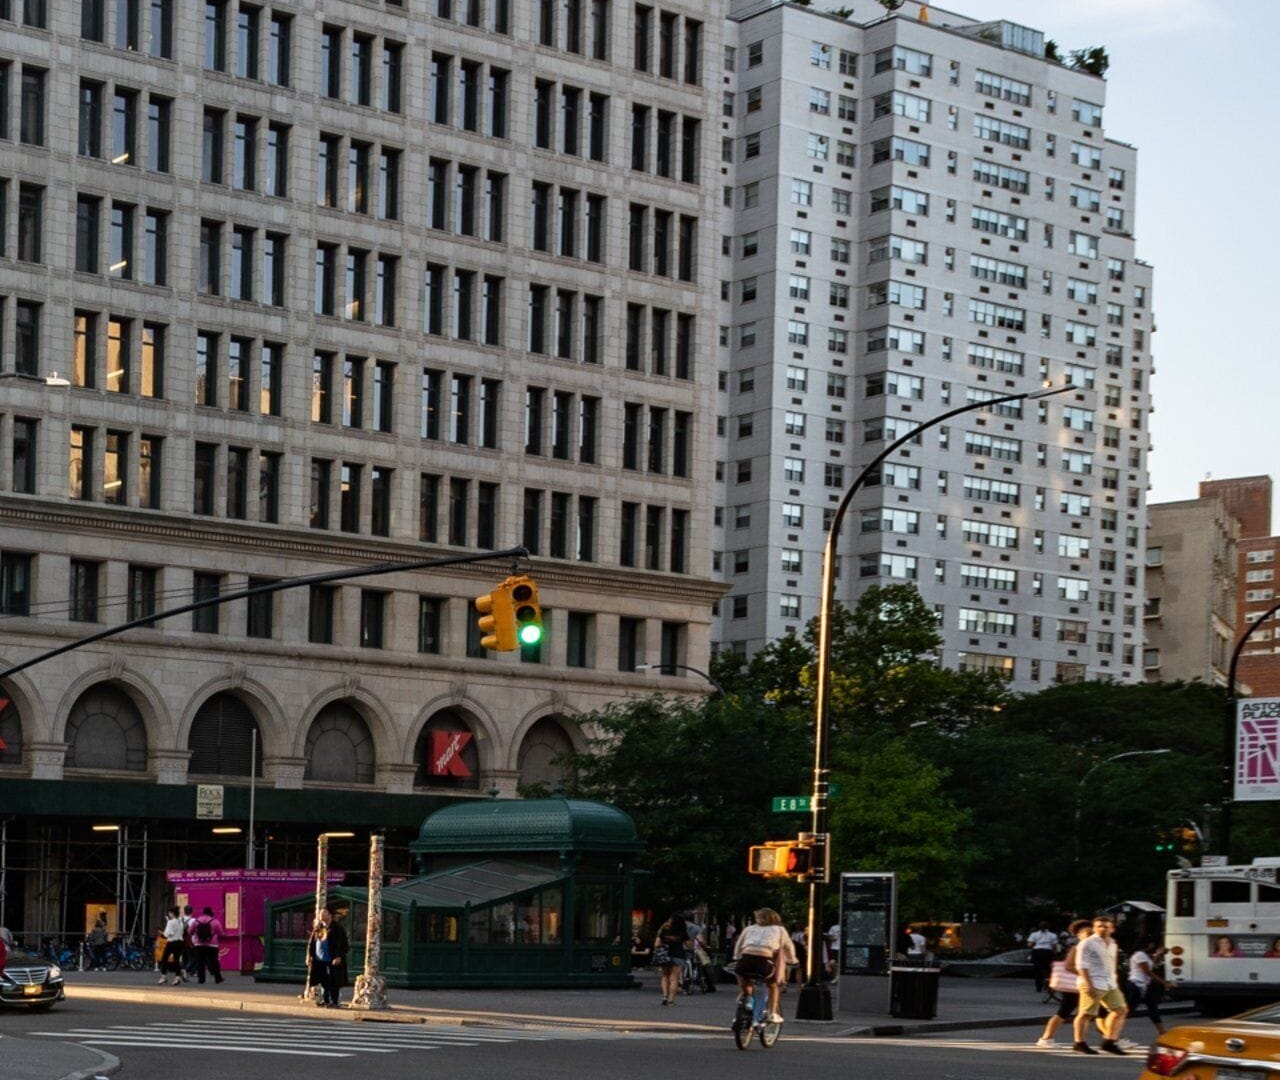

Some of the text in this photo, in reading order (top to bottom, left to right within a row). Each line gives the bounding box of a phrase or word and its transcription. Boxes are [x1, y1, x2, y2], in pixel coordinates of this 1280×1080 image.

[433, 729, 473, 776] K mart
[780, 799, 786, 810] E
[790, 799, 796, 810] 8
